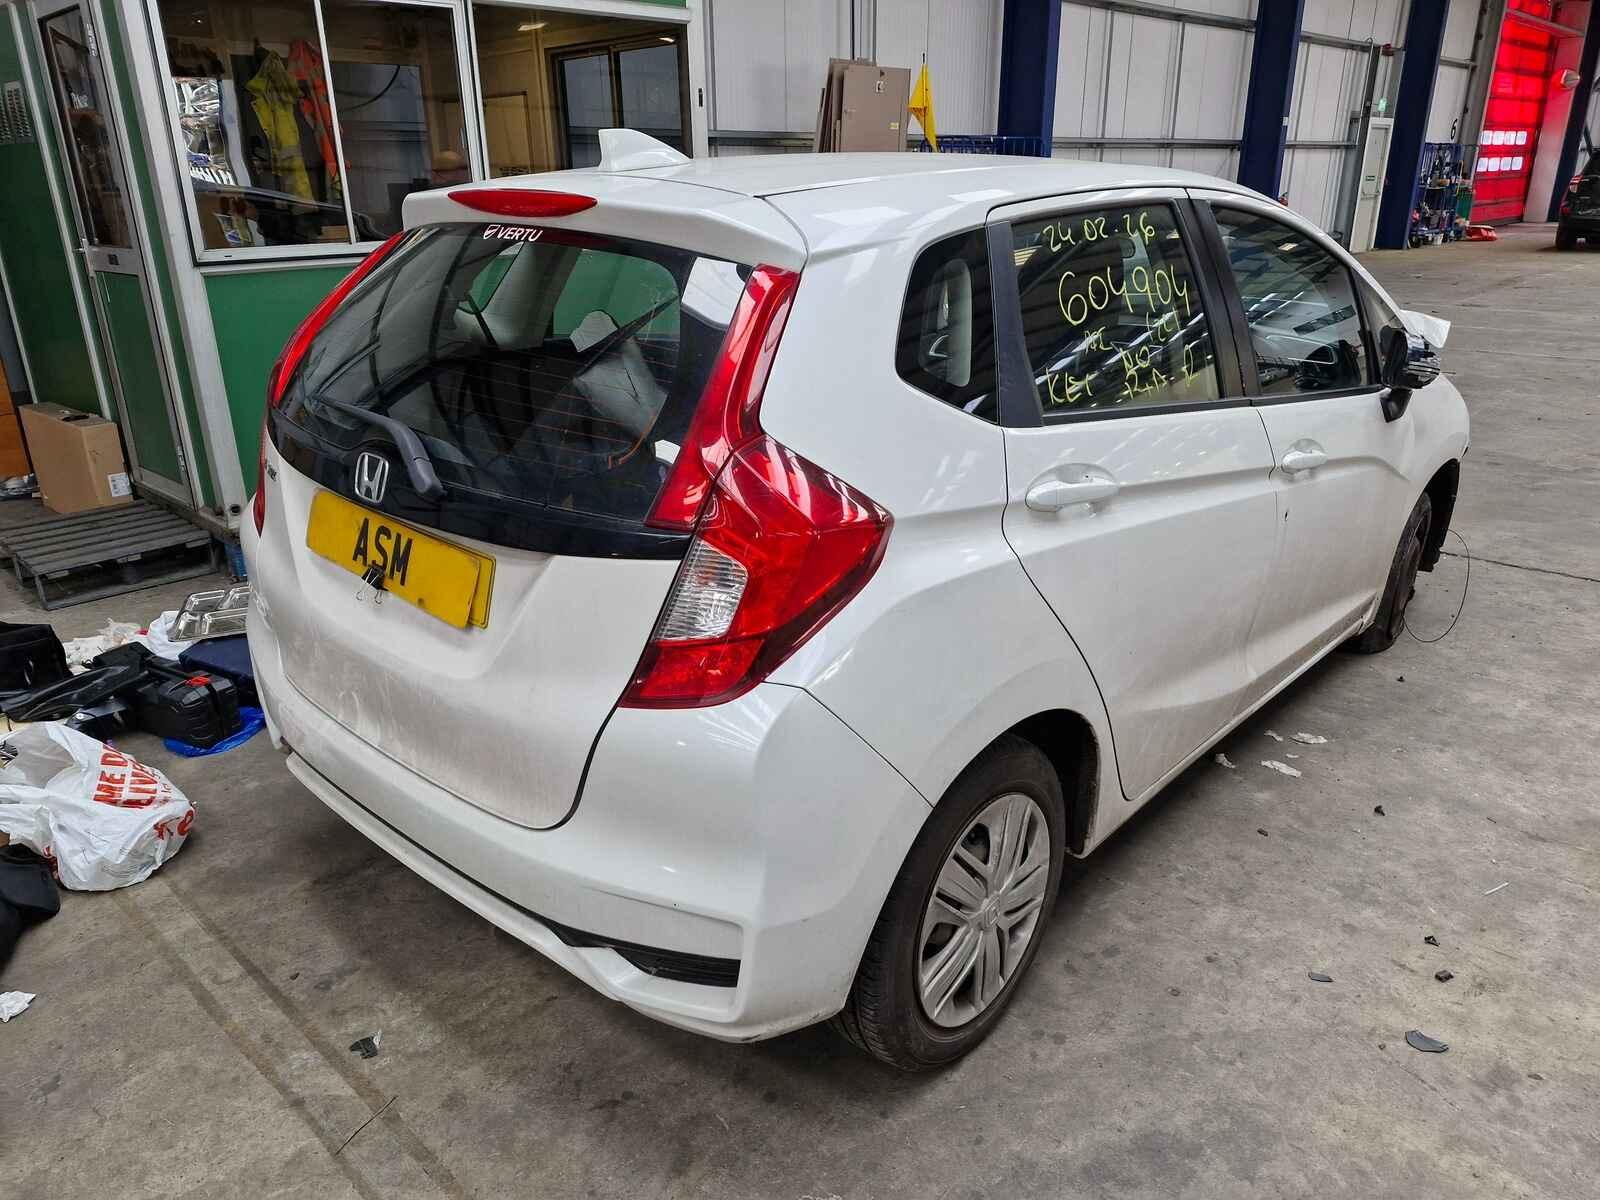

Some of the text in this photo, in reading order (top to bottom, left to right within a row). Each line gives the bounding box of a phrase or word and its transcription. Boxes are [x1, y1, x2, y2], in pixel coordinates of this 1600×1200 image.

[497, 222, 544, 242] VERTU
[1058, 264, 1191, 326] 604904
[352, 517, 413, 586] ASM
